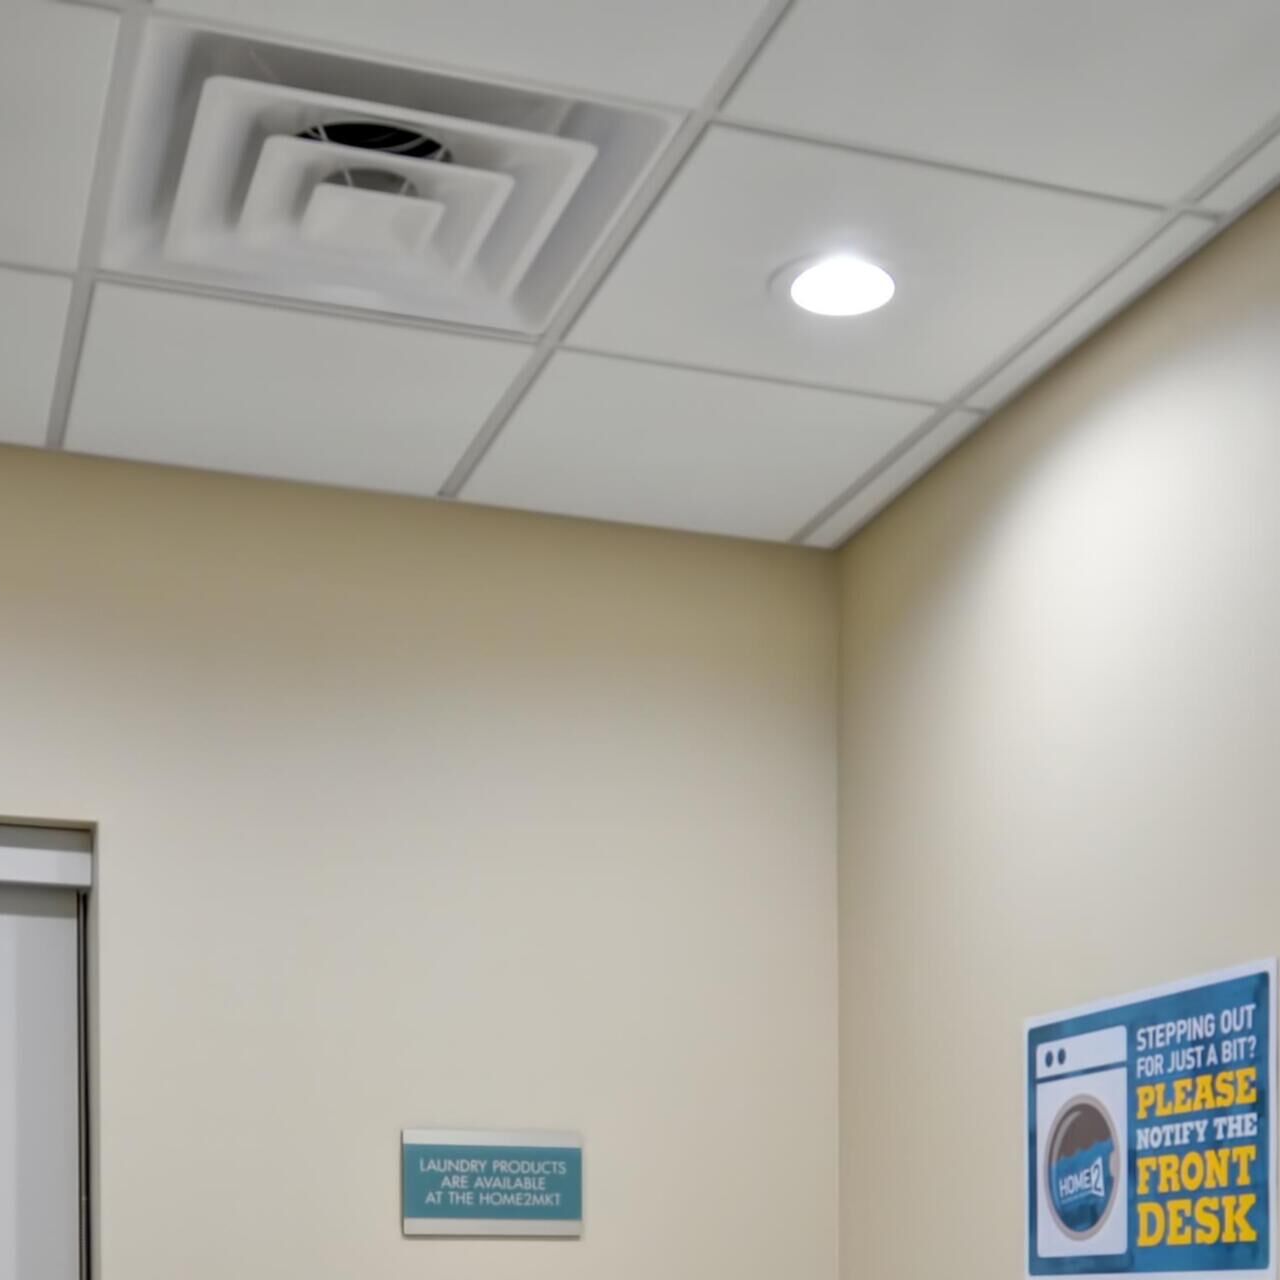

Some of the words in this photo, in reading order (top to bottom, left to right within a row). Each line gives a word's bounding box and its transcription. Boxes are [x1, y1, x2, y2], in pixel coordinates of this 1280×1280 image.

[1136, 1013, 1215, 1051] STEPPING
[1220, 1004, 1256, 1034] OUT
[1136, 1055, 1164, 1078] FOR
[1167, 1046, 1203, 1074] JUST
[1206, 1044, 1218, 1066] A
[1221, 1035, 1257, 1063] BIT?
[1136, 1067, 1257, 1119] PLEASE
[1136, 1119, 1209, 1150] NOTIFY
[1214, 1112, 1258, 1140] THE
[419, 1158, 487, 1174] LAUNDRY
[492, 1159, 567, 1175] PRODUCTS
[440, 1175, 468, 1189] ARE
[474, 1176, 546, 1191] AVAILABLE
[1136, 1145, 1257, 1195] FRONT
[425, 1191, 444, 1205] AT
[448, 1191, 474, 1205] THE
[479, 1192, 561, 1207] HOME2MKT
[1136, 1193, 1258, 1247] DESK
